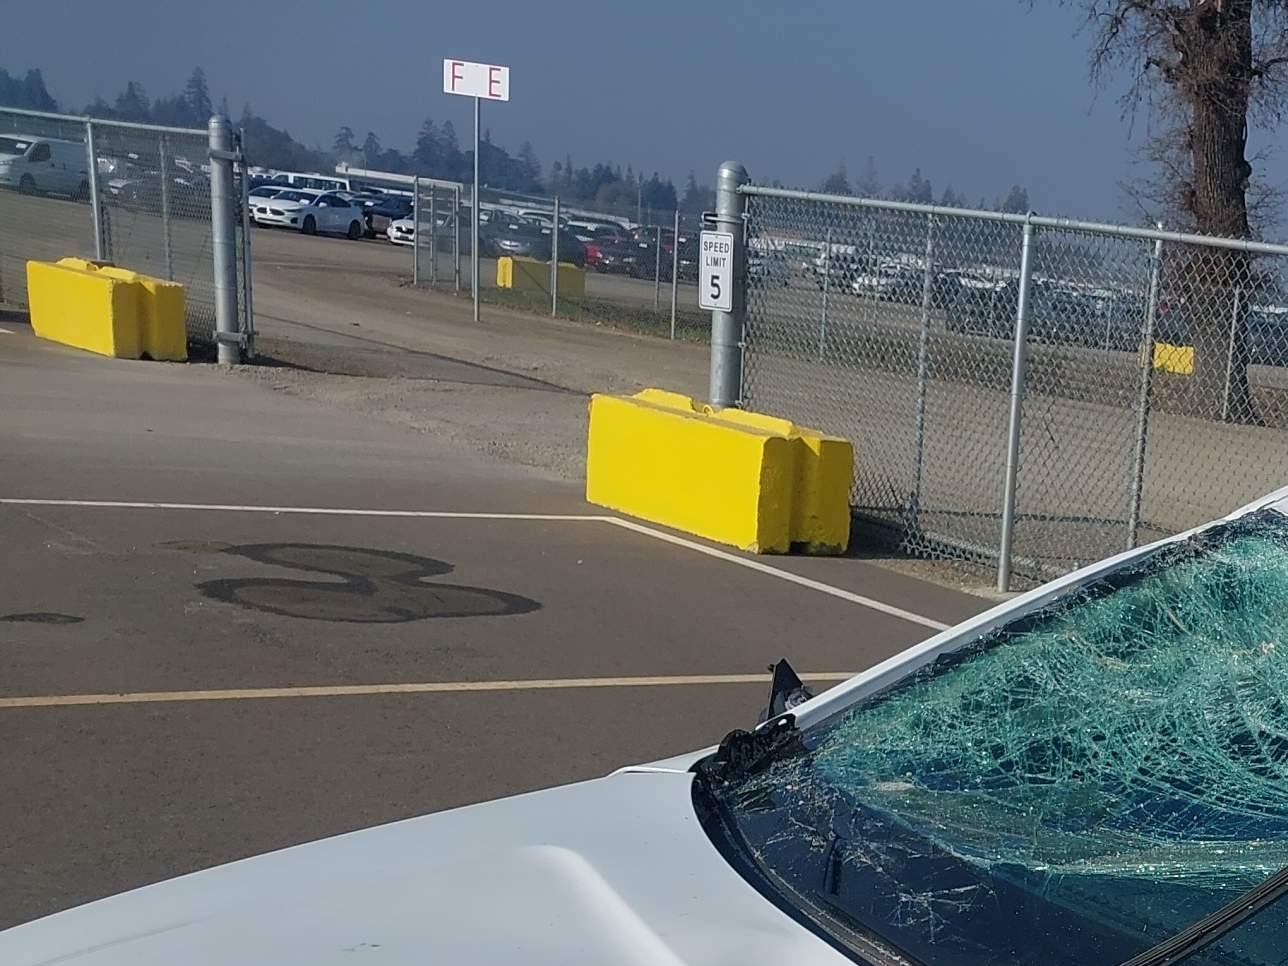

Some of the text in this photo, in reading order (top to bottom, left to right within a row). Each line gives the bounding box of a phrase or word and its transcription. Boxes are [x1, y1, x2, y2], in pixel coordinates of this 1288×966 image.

[451, 62, 502, 97] F E
[703, 241, 730, 254] SPEED
[706, 256, 727, 269] LIMIT
[710, 274, 721, 300] 5
